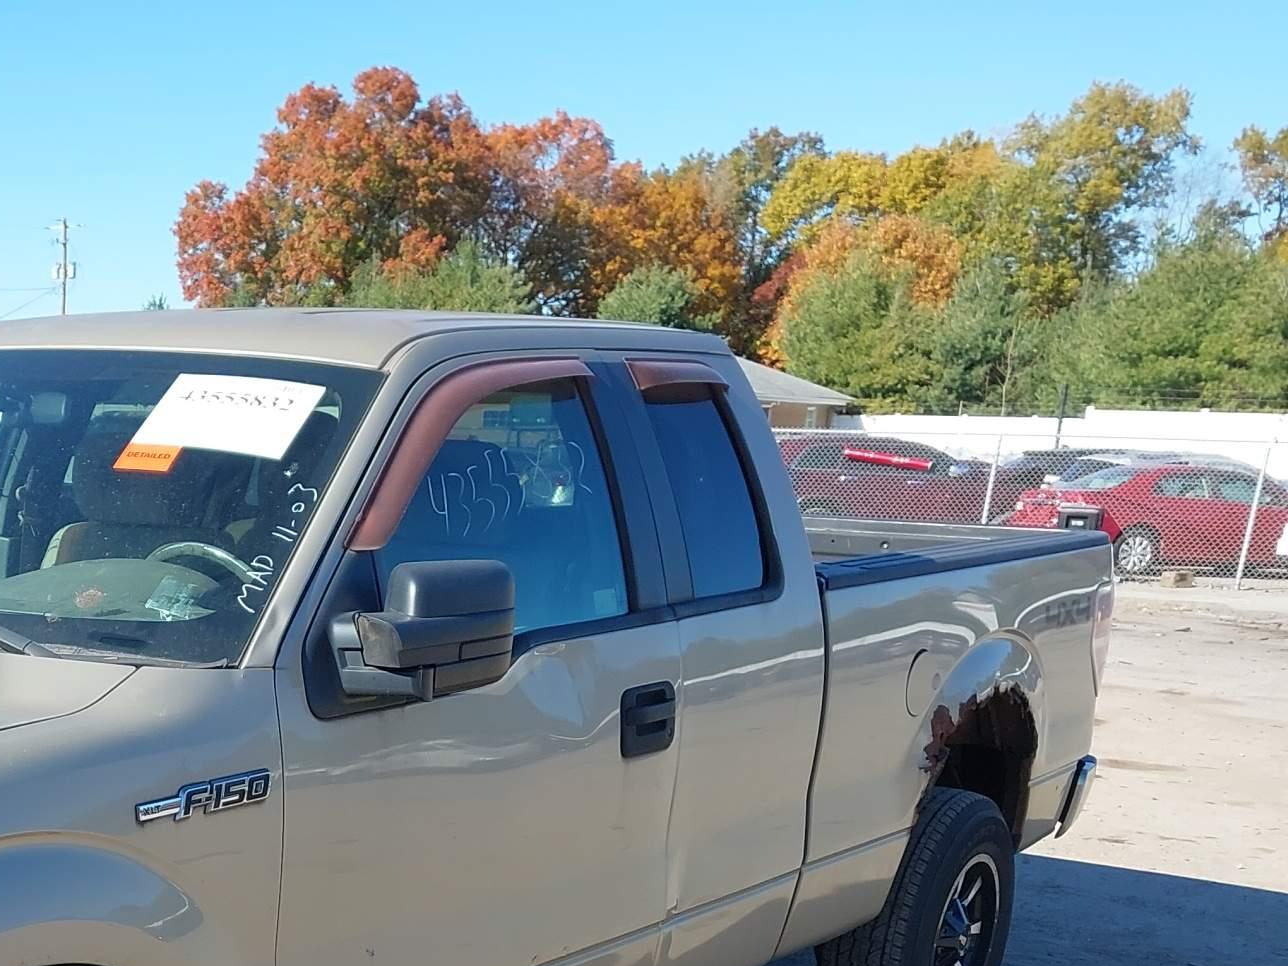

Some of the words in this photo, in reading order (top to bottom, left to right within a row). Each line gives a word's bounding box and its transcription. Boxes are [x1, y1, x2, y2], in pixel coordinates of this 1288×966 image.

[124, 449, 172, 460] DETAILED
[272, 482, 319, 542] 11-03
[175, 769, 273, 822] F-150
